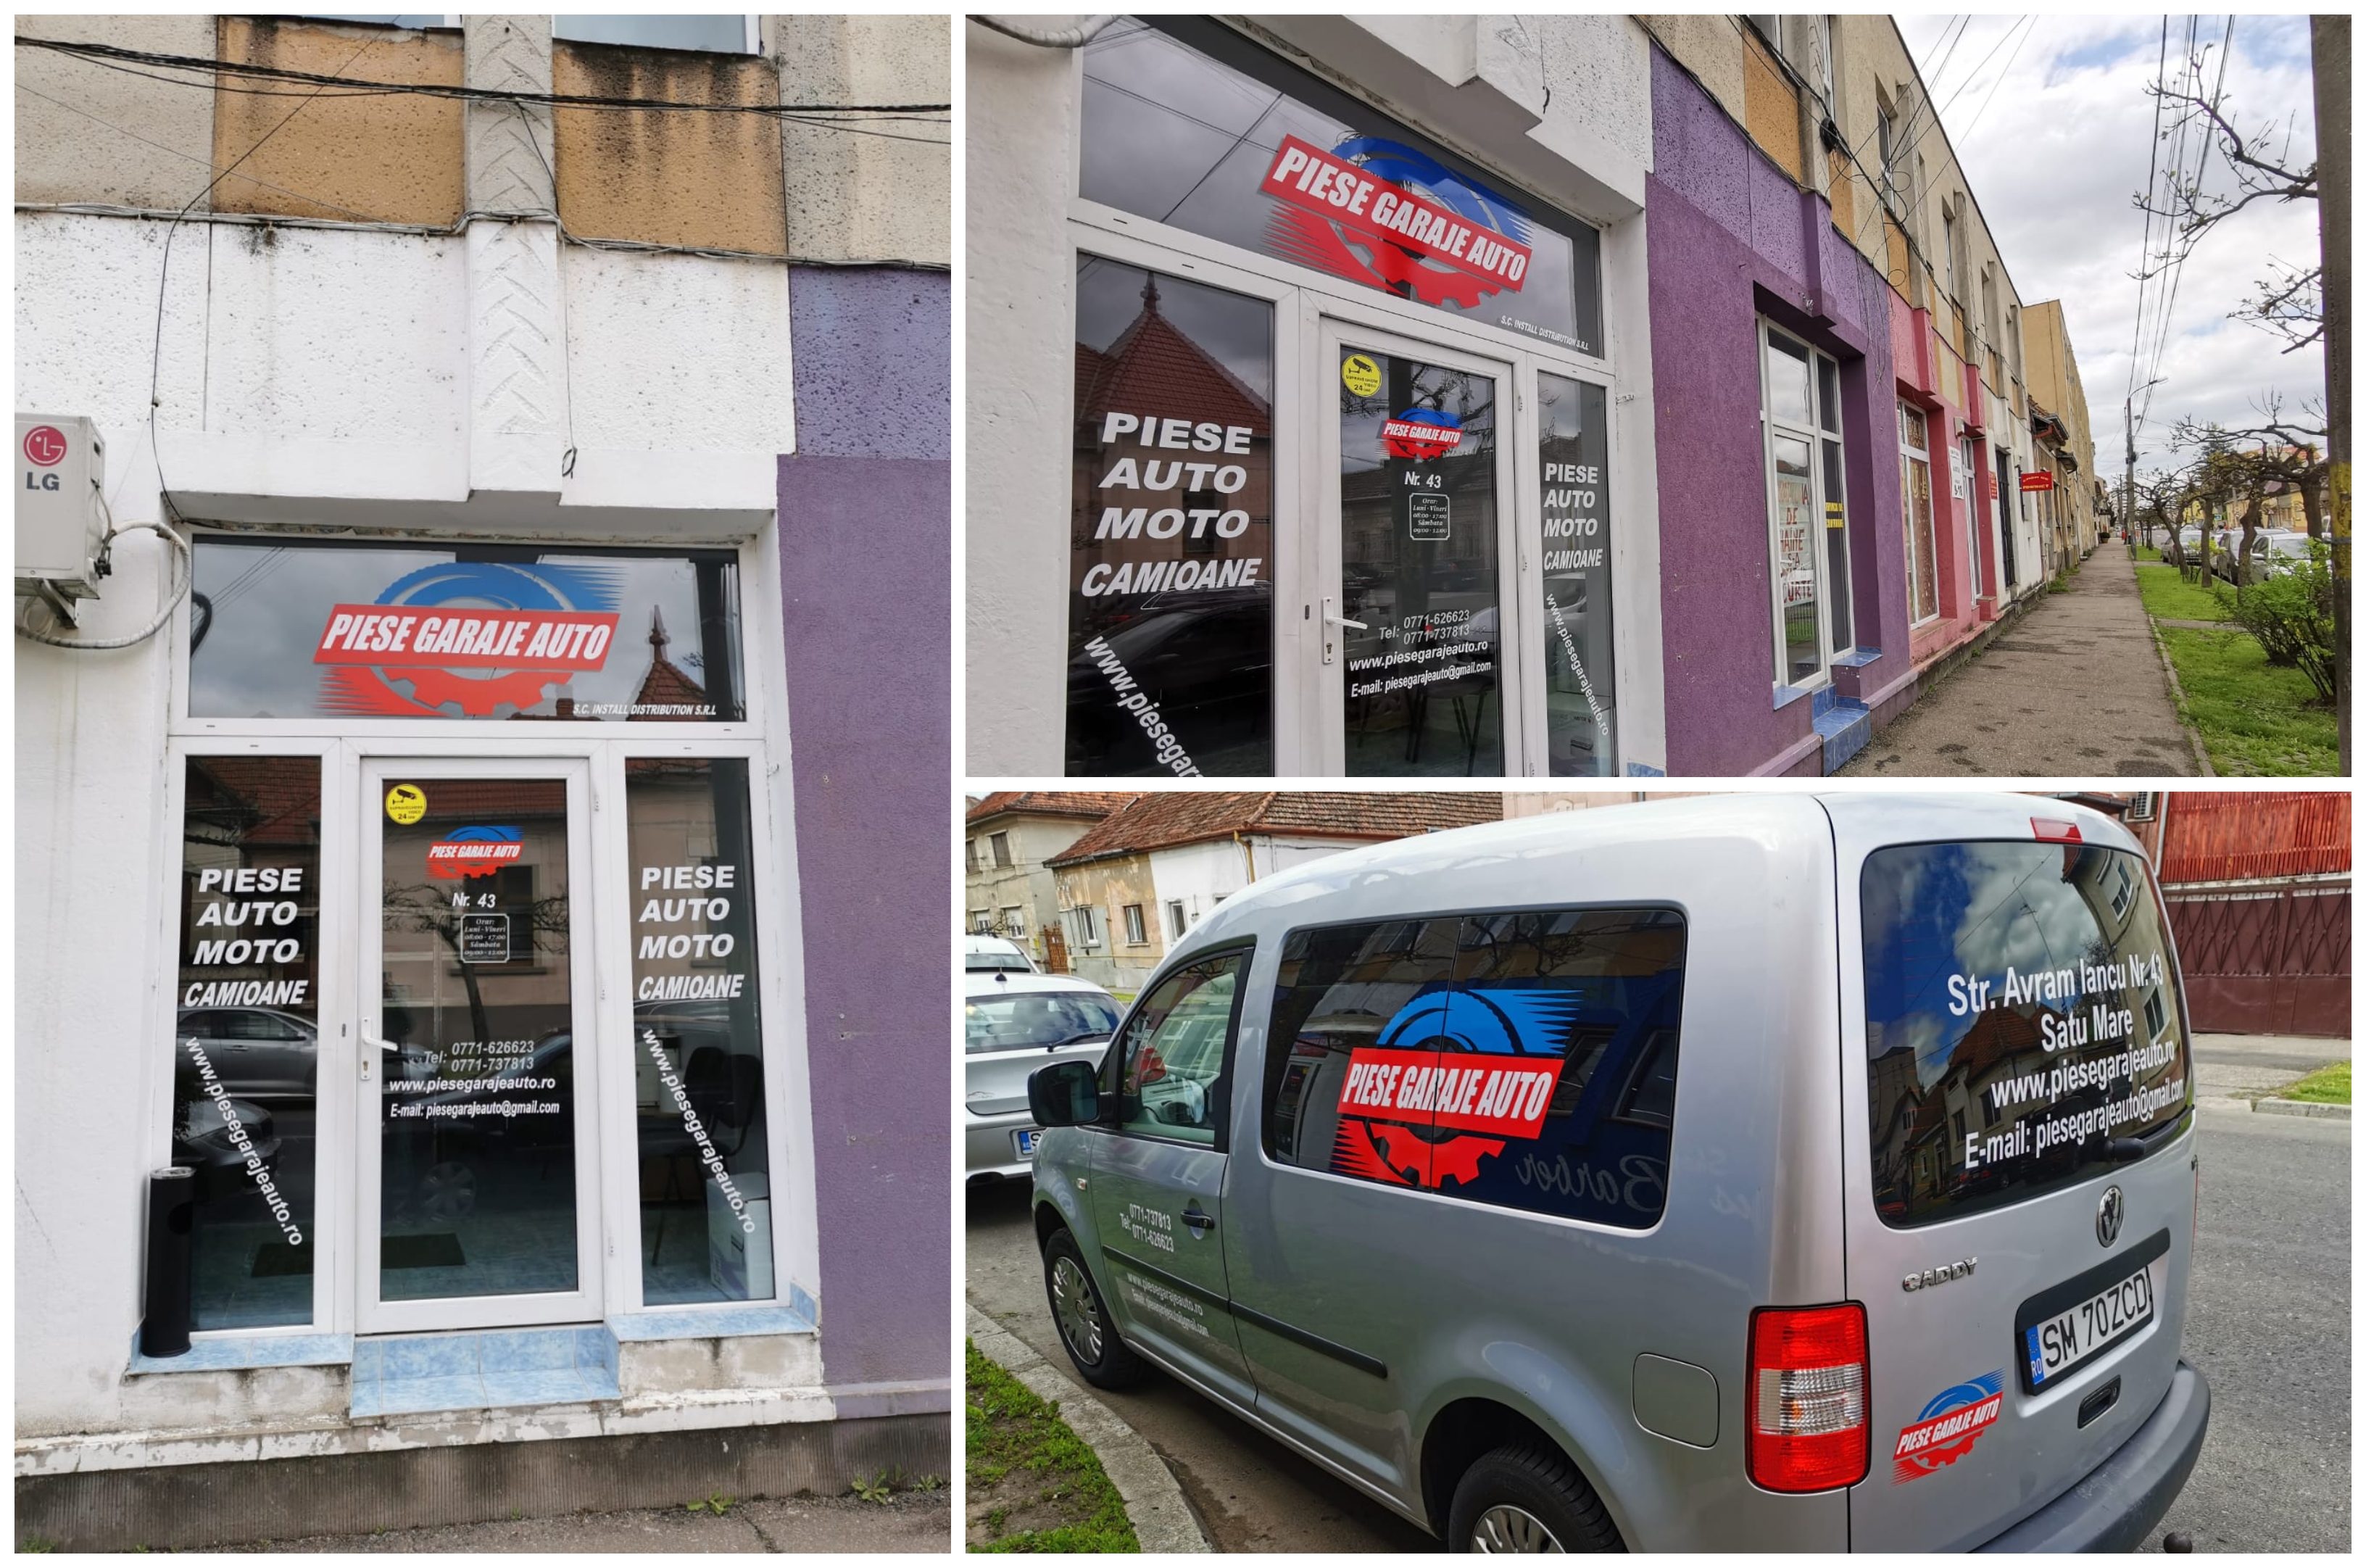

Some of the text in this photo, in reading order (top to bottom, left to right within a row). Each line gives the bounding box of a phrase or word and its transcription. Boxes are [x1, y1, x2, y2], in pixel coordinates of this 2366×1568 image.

[1272, 146, 1527, 281] PIESE GARAJE AUTO
[1501, 315, 1513, 326] S.C.
[1514, 320, 1538, 334] INSTALL
[1539, 328, 1577, 346] DISTRIBUTION
[1102, 412, 1253, 455] PIESE
[1383, 423, 1461, 443] PIESE GARAJE AUTO
[26, 472, 59, 491] LG
[1097, 457, 1247, 494] AUTO
[1404, 471, 1441, 489] Nr. 43
[1545, 462, 1598, 484] PIESE
[1543, 489, 1595, 508] AUTO
[1094, 507, 1249, 539] MOTO
[1544, 518, 1598, 537] MOTO
[1544, 549, 1603, 571] CAMIOANE
[1081, 558, 1262, 597] CAMIOANE
[1403, 609, 1470, 629] 0771-626623
[322, 614, 610, 660] PIESE GARAJE AUTO
[1379, 625, 1400, 640] Tel:
[1403, 624, 1470, 644] 0771-737813
[1350, 640, 1487, 671] www.piesegarajeauto.ro
[1546, 593, 1609, 736] www.piesegarajeauto.ro
[1351, 661, 1491, 697] E-mail: piesegarajeauto@gmail.com
[573, 704, 716, 715] S.C. INSTALL DISTRIBUTION S.R.L
[1084, 636, 1205, 777] www.piesegar
[429, 845, 520, 858] PIESE GARAJE AUTO
[199, 868, 303, 892] PIESE
[641, 866, 735, 890] PIESE
[452, 892, 496, 908] Nr. 43
[639, 897, 729, 922] AUTO
[196, 901, 298, 926] AUTO
[193, 939, 299, 964] MOTO
[639, 933, 734, 959] MOTO
[184, 980, 309, 1007] CAMIOANE
[639, 974, 744, 1000] CAMIOANE
[1948, 952, 2164, 1016] Str. Avram Iancu Nr. 43
[2041, 1003, 2133, 1053] Satu Mare
[424, 1051, 447, 1064] Tel:
[452, 1040, 534, 1055] 0771-626623
[451, 1057, 534, 1072] 0771-737813
[1991, 1040, 2175, 1108] www.piesegarajeauto.ro
[389, 1077, 556, 1093] www.piesegarajeauto.ro
[1342, 1063, 1552, 1121] PIESE GARAJE AUTO
[390, 1100, 560, 1119] E-mail: piesegarajeauto@gmail.com
[642, 1029, 755, 1234] www.piesegarajeauto.ro
[1965, 1077, 2184, 1169] E-mail: piesegarajeauto@gmail.com
[185, 1037, 302, 1245] www.piesegarajeauto.ro
[1129, 1203, 1171, 1231] 0771-737813
[1132, 1224, 1174, 1253] 0771-626623
[1902, 1256, 1978, 1293] CADDY
[2043, 1314, 2078, 1368] SM
[2031, 1358, 2042, 1377] RO
[1896, 1398, 2001, 1455] PIESE GARAJE AUTO
